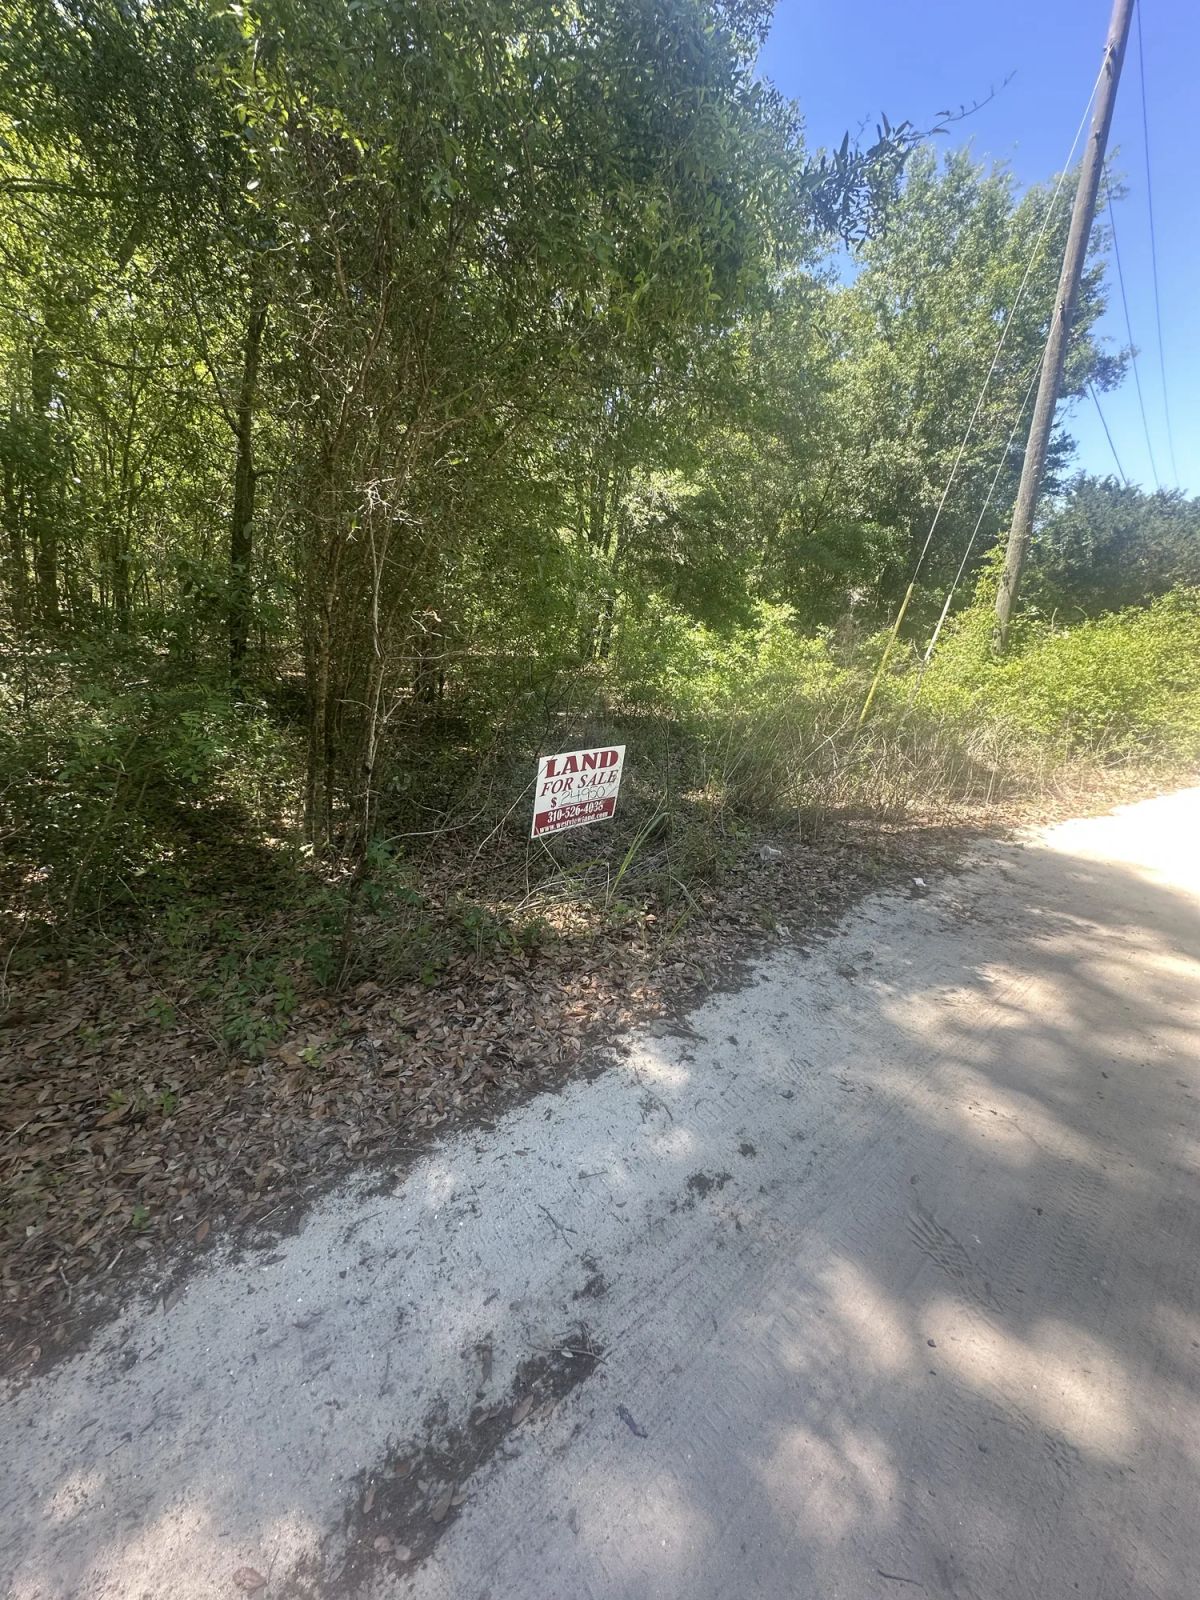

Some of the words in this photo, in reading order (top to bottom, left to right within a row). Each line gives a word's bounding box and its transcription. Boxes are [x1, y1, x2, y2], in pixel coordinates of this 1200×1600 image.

[545, 750, 619, 778] LAND
[540, 777, 574, 797] FOR
[577, 770, 619, 789] SALE
[550, 797, 557, 808] $
